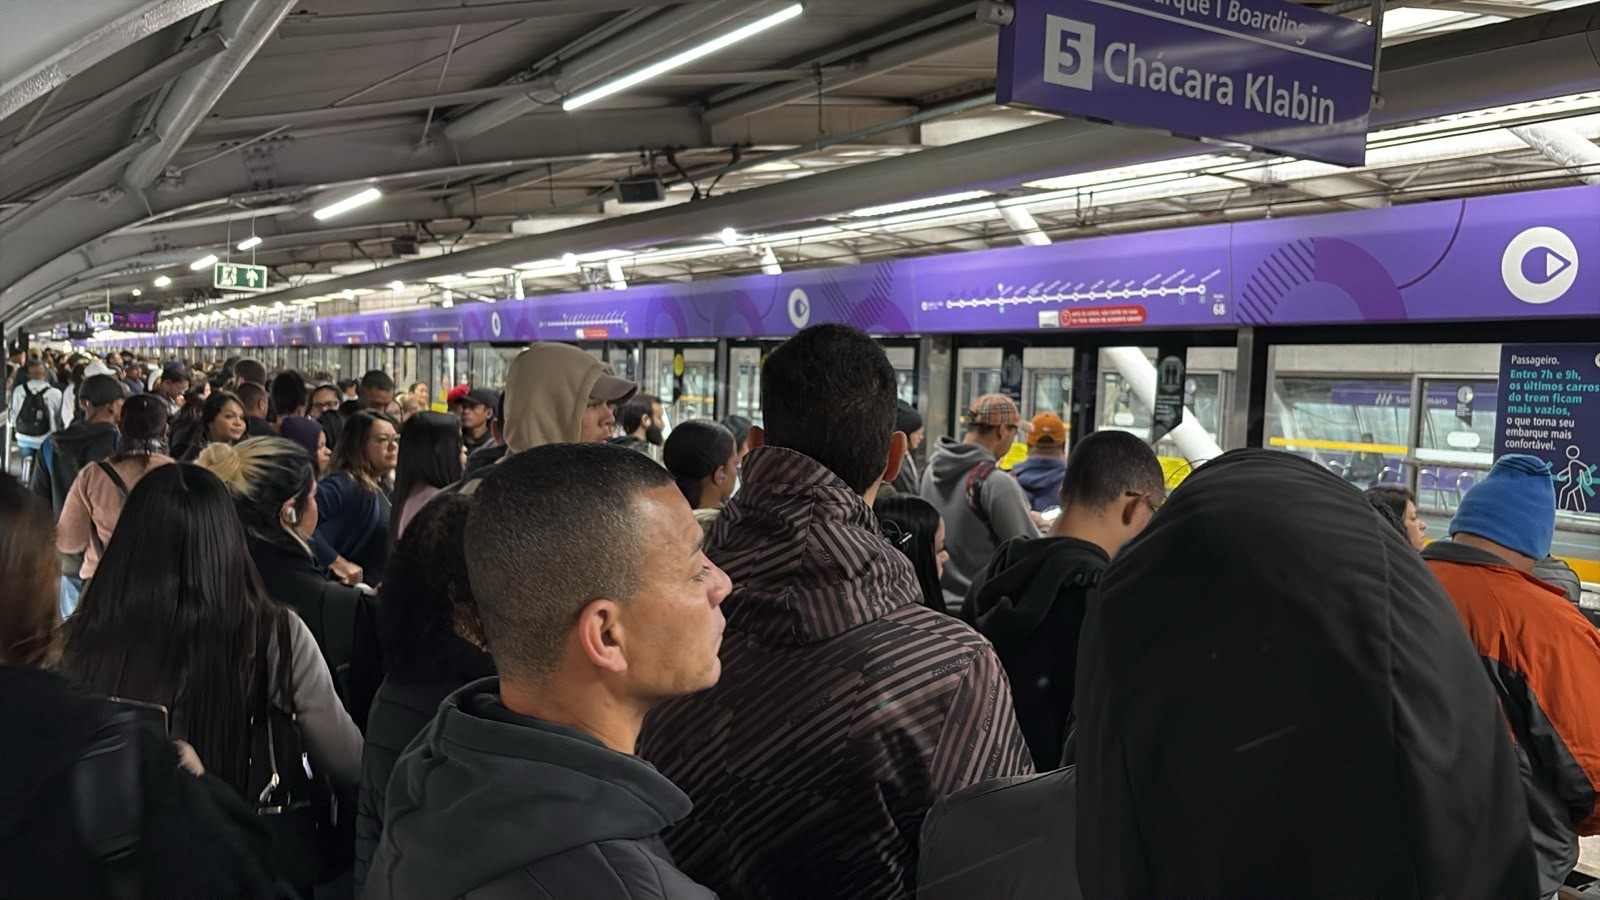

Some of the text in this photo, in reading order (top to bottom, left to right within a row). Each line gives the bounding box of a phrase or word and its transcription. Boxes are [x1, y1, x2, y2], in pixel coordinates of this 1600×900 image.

[1226, 6, 1311, 46] Boarding
[1057, 29, 1336, 126] 5 Chácara Klabin
[1511, 354, 1560, 367] Passageiro.
[1510, 369, 1582, 380] Entre 7h e 9h,
[1509, 381, 1600, 392] os últimos carros
[1508, 392, 1583, 404] do trem ficam
[1507, 404, 1571, 416] mais vazios,
[1506, 417, 1575, 428] o que torna seu
[1505, 427, 1572, 439] embarque mais
[1505, 438, 1556, 450] confortável.
